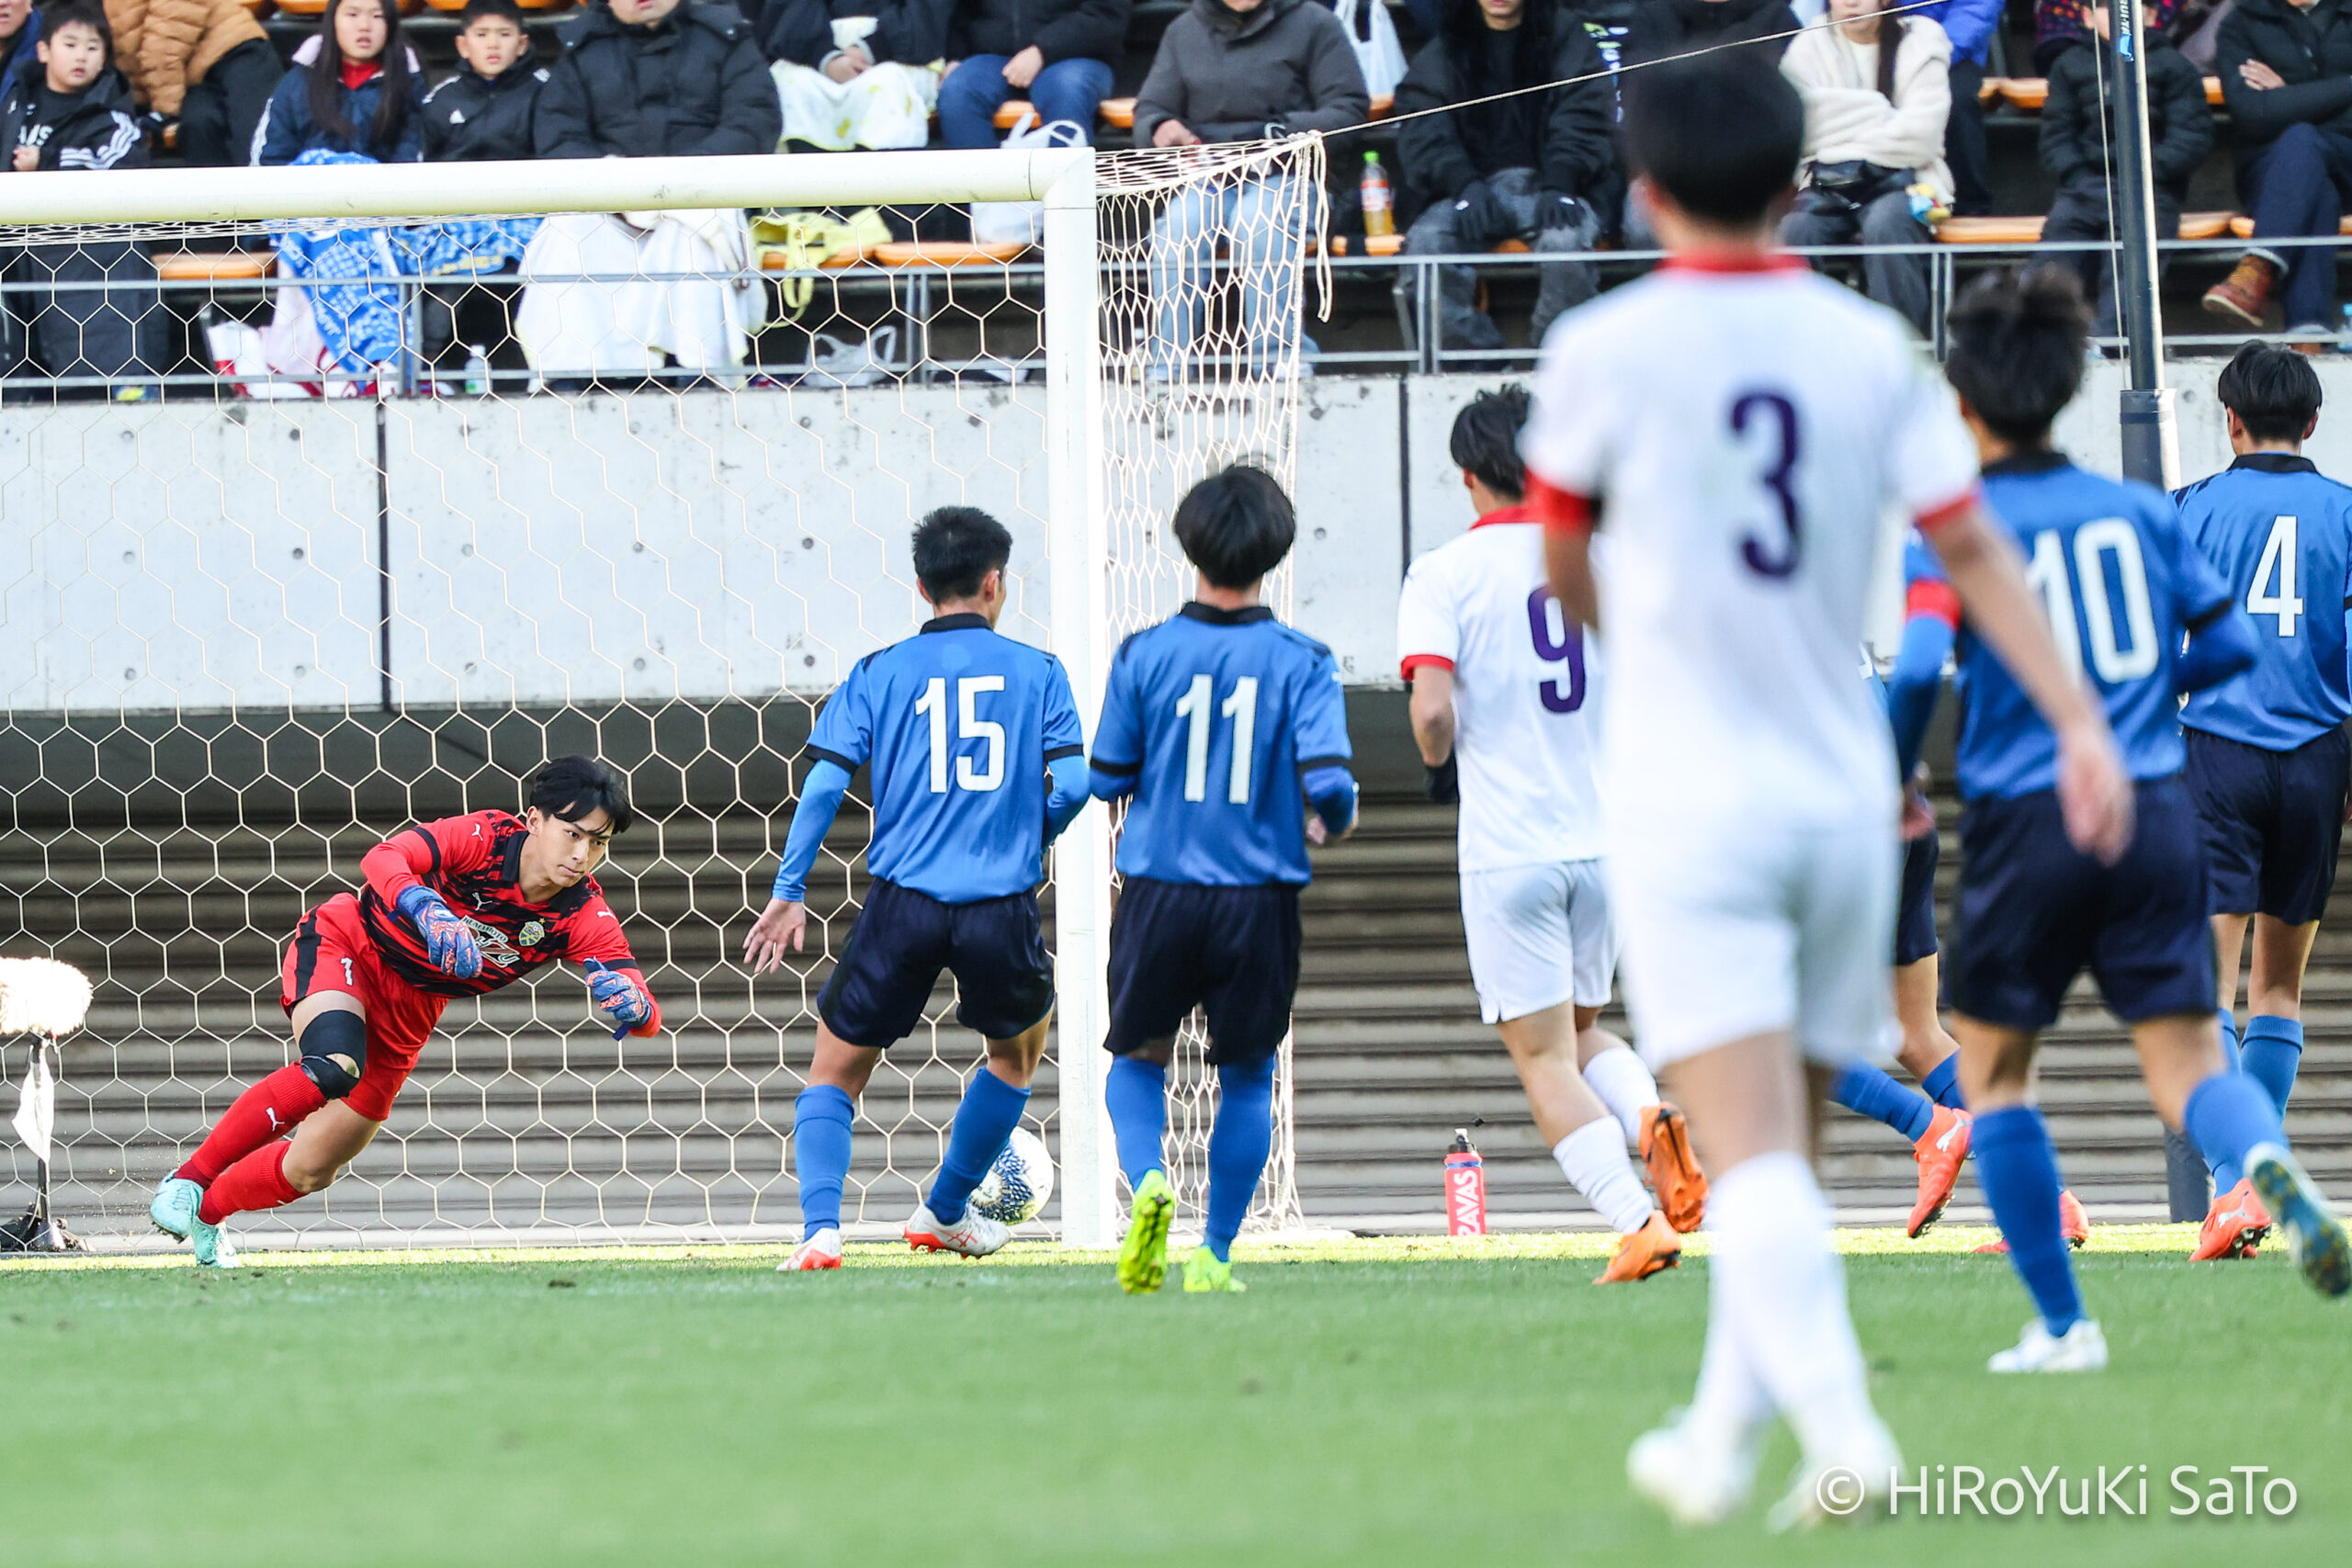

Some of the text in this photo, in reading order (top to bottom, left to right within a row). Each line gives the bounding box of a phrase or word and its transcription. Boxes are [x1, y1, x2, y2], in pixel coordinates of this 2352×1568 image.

[1730, 389, 1803, 580] 3
[2025, 516, 2159, 689] 10
[2246, 515, 2303, 637] 4
[1527, 582, 1586, 714] 9
[915, 675, 1005, 793] 15
[1176, 674, 1258, 804] 11
[340, 957, 353, 986] 1
[469, 929, 520, 967] HZU
